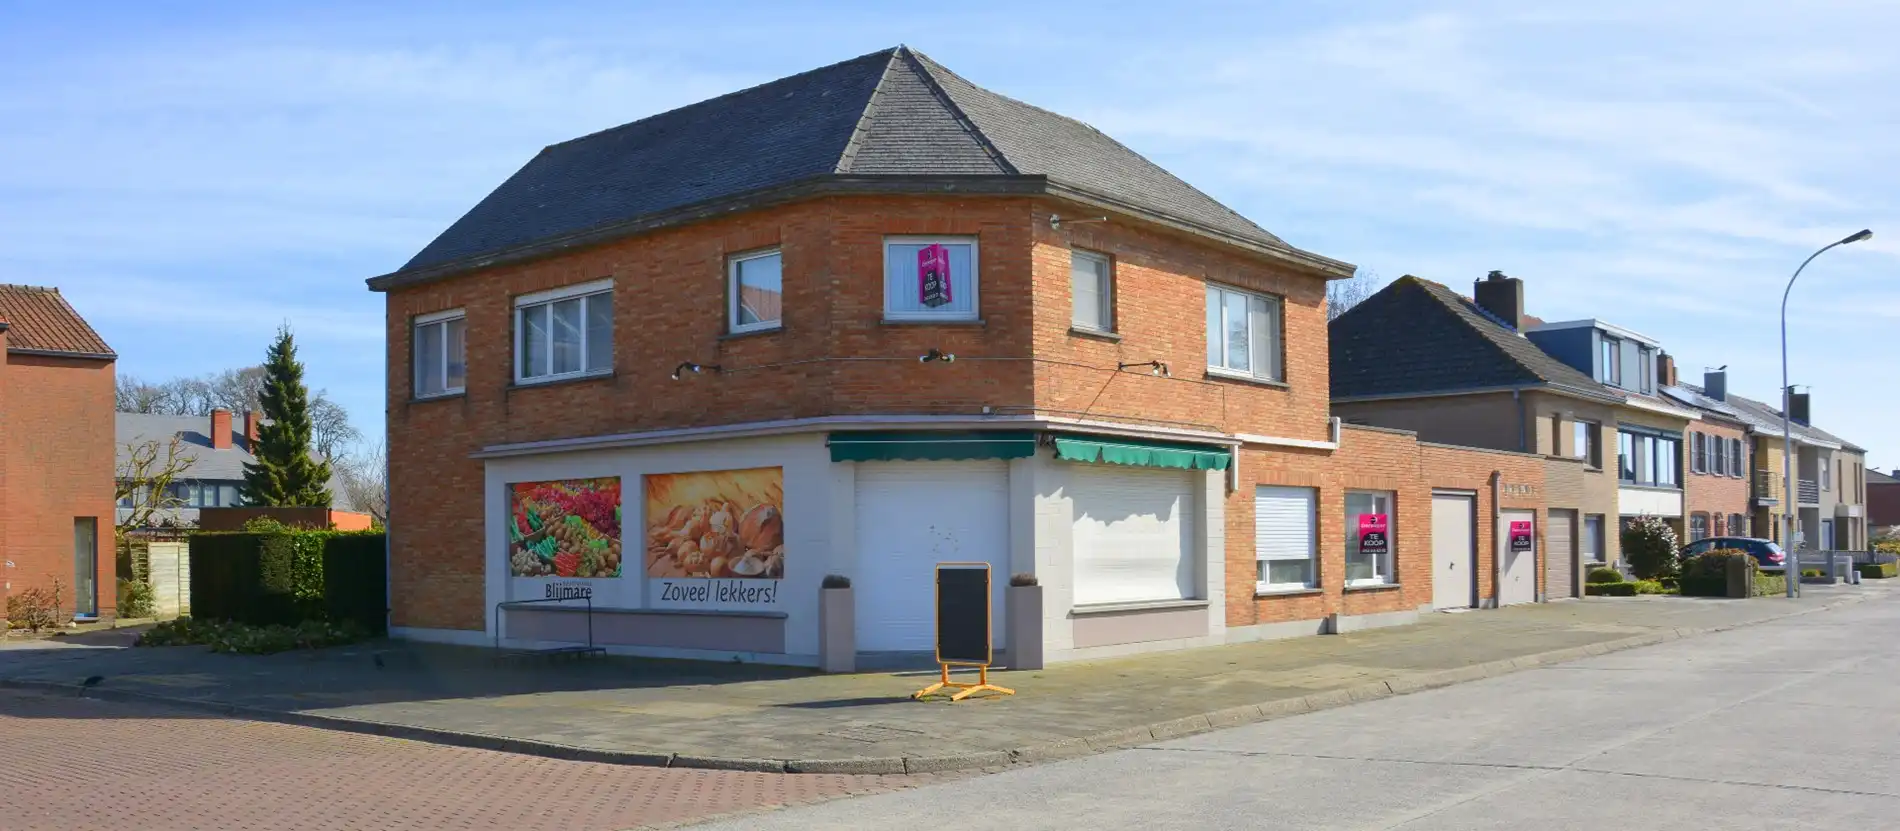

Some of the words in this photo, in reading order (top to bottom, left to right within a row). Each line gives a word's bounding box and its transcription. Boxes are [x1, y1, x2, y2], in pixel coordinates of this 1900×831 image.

[545, 582, 592, 603] Blijmare
[661, 579, 711, 602] Zoveel
[715, 579, 778, 603] lekkers!
